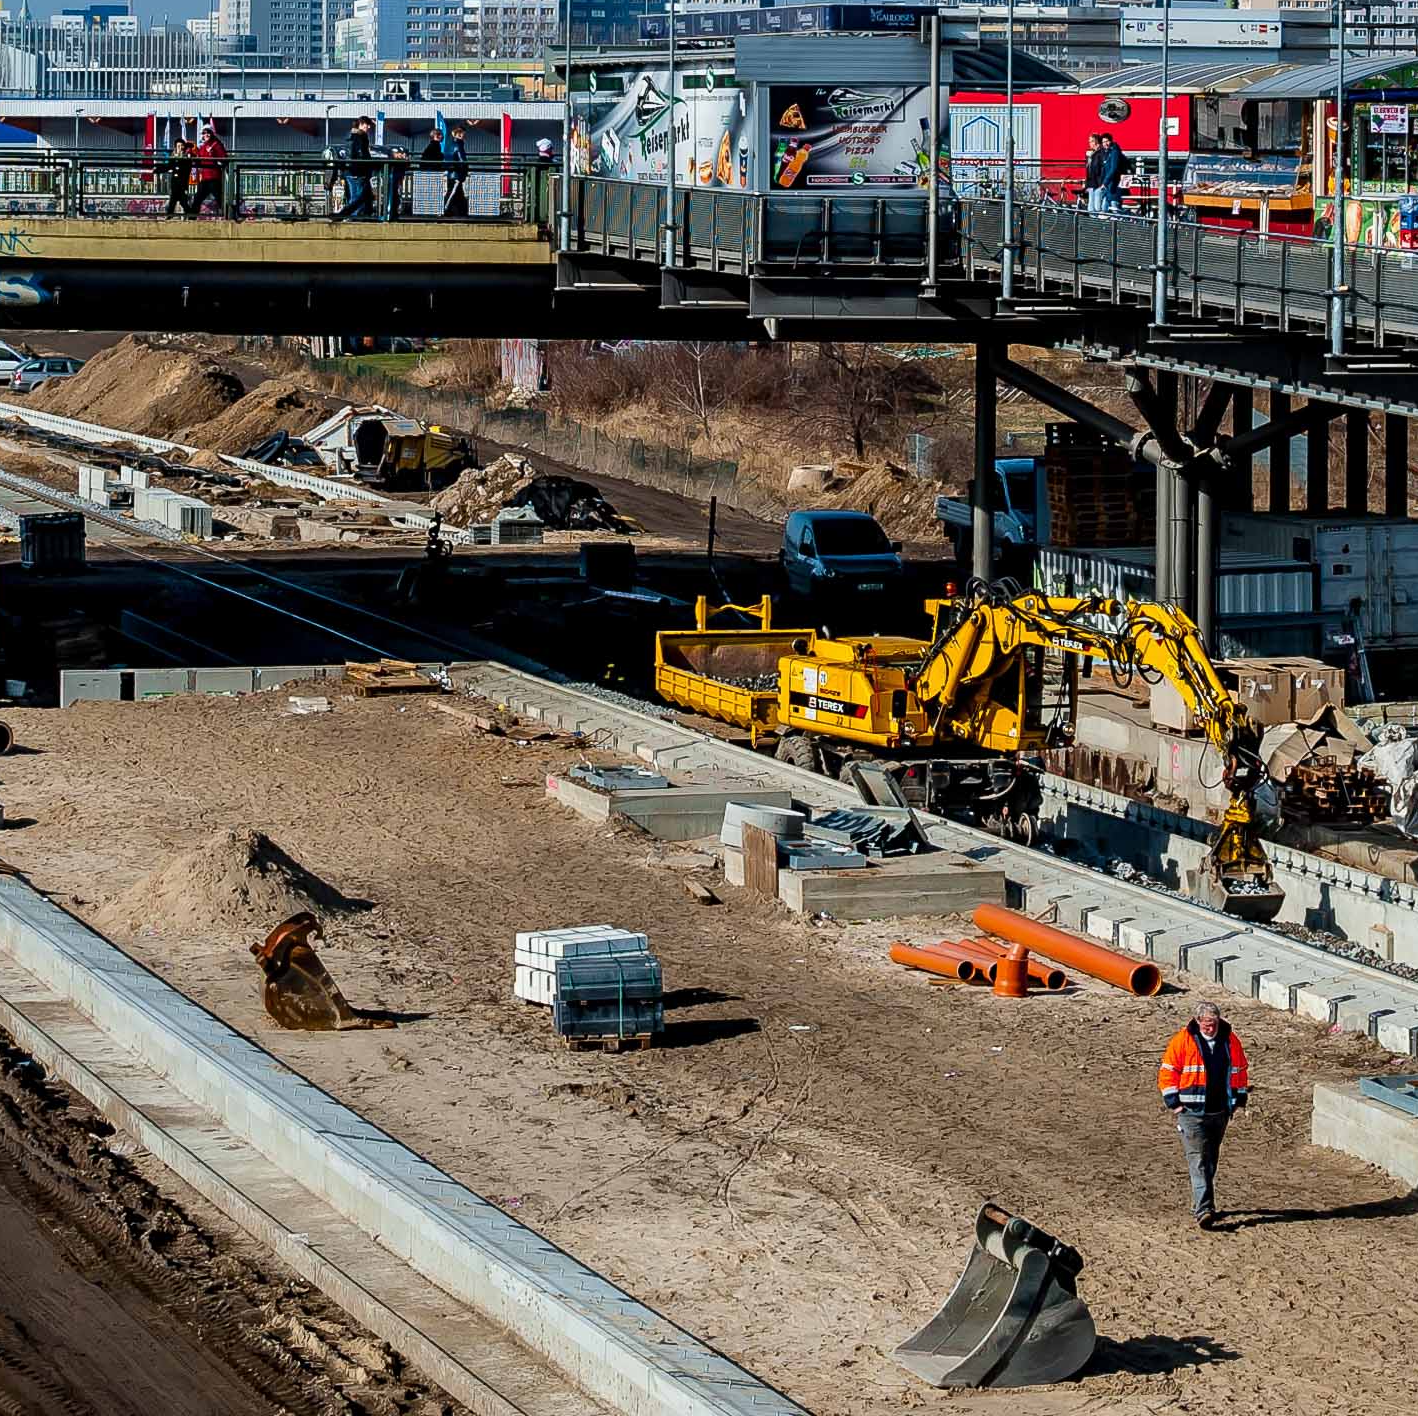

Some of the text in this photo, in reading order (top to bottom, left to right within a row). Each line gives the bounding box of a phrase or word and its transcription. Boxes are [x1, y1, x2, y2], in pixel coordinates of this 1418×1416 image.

[836, 100, 895, 118] Reisemarkt
[845, 147, 875, 155] PIZZA
[817, 699, 844, 713] TEREX
